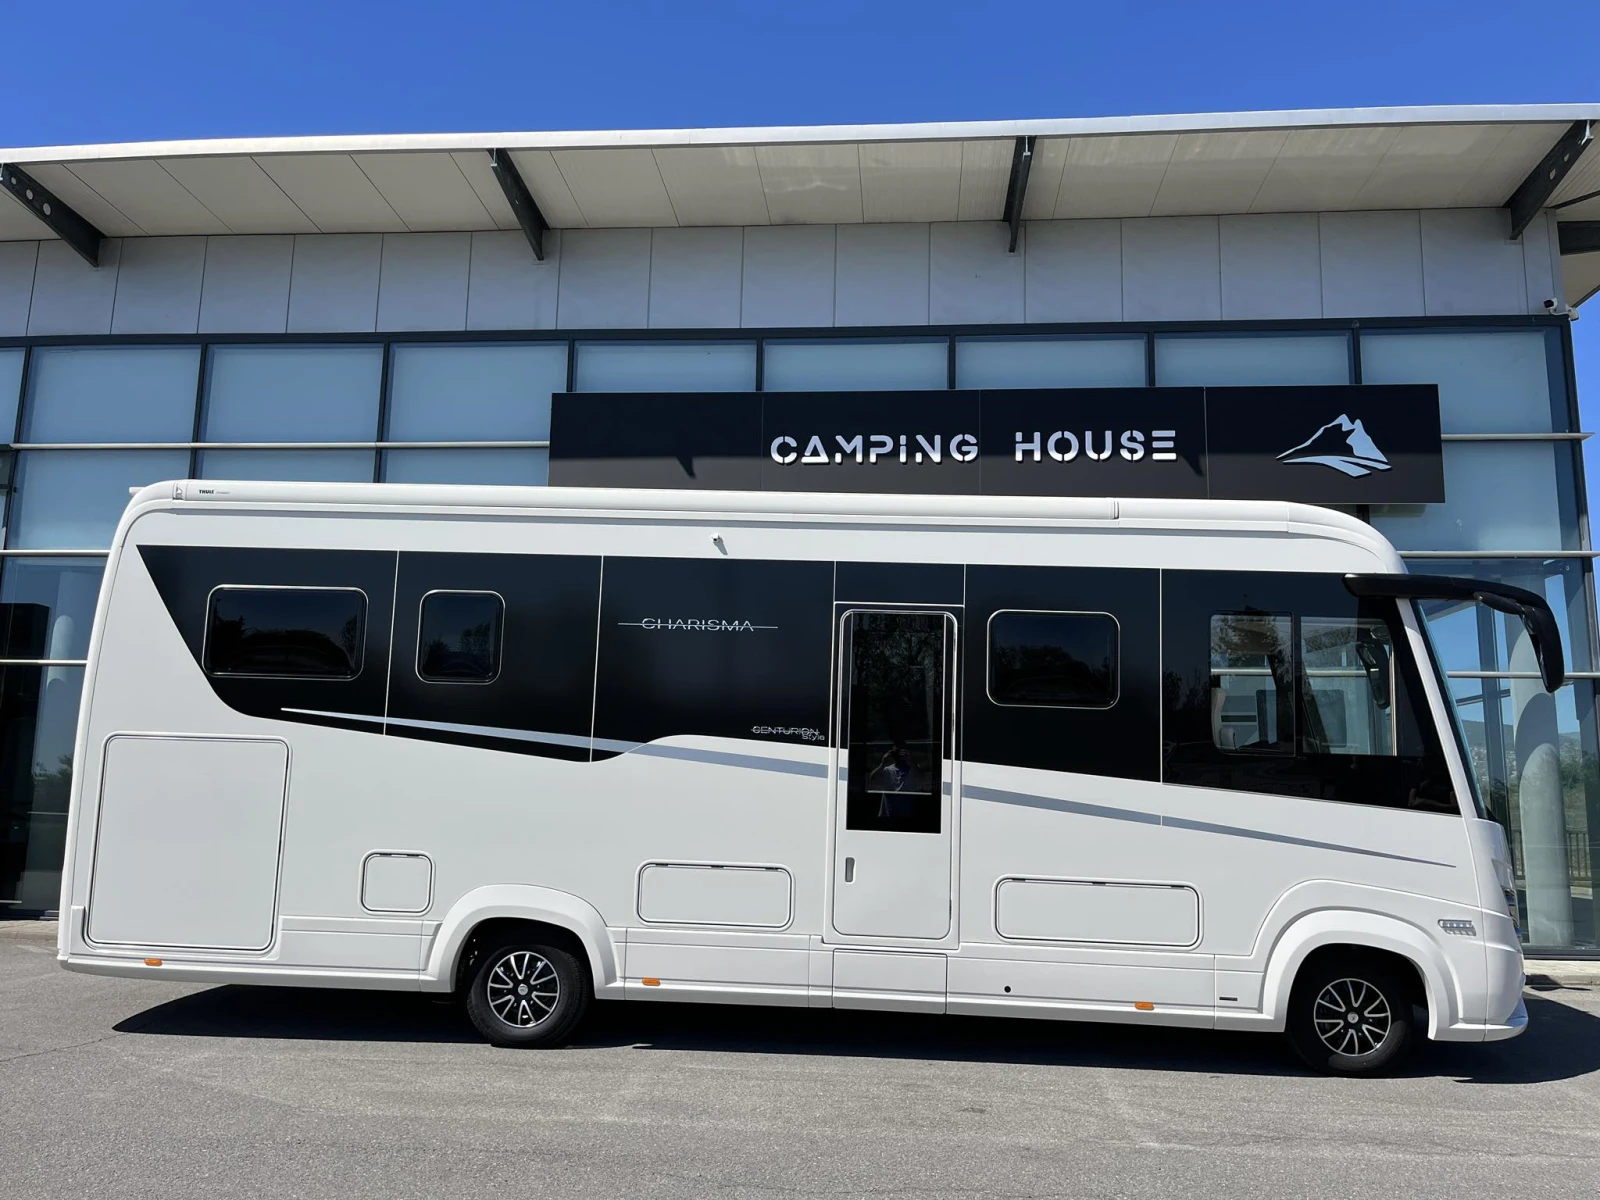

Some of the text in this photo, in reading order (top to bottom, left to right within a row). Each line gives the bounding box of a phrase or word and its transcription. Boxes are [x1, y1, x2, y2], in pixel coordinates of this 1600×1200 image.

[1015, 430, 1177, 462] HOUSE
[642, 617, 754, 632] CHARISMA
[752, 725, 819, 735] CENTURION
[801, 733, 825, 741] Style
